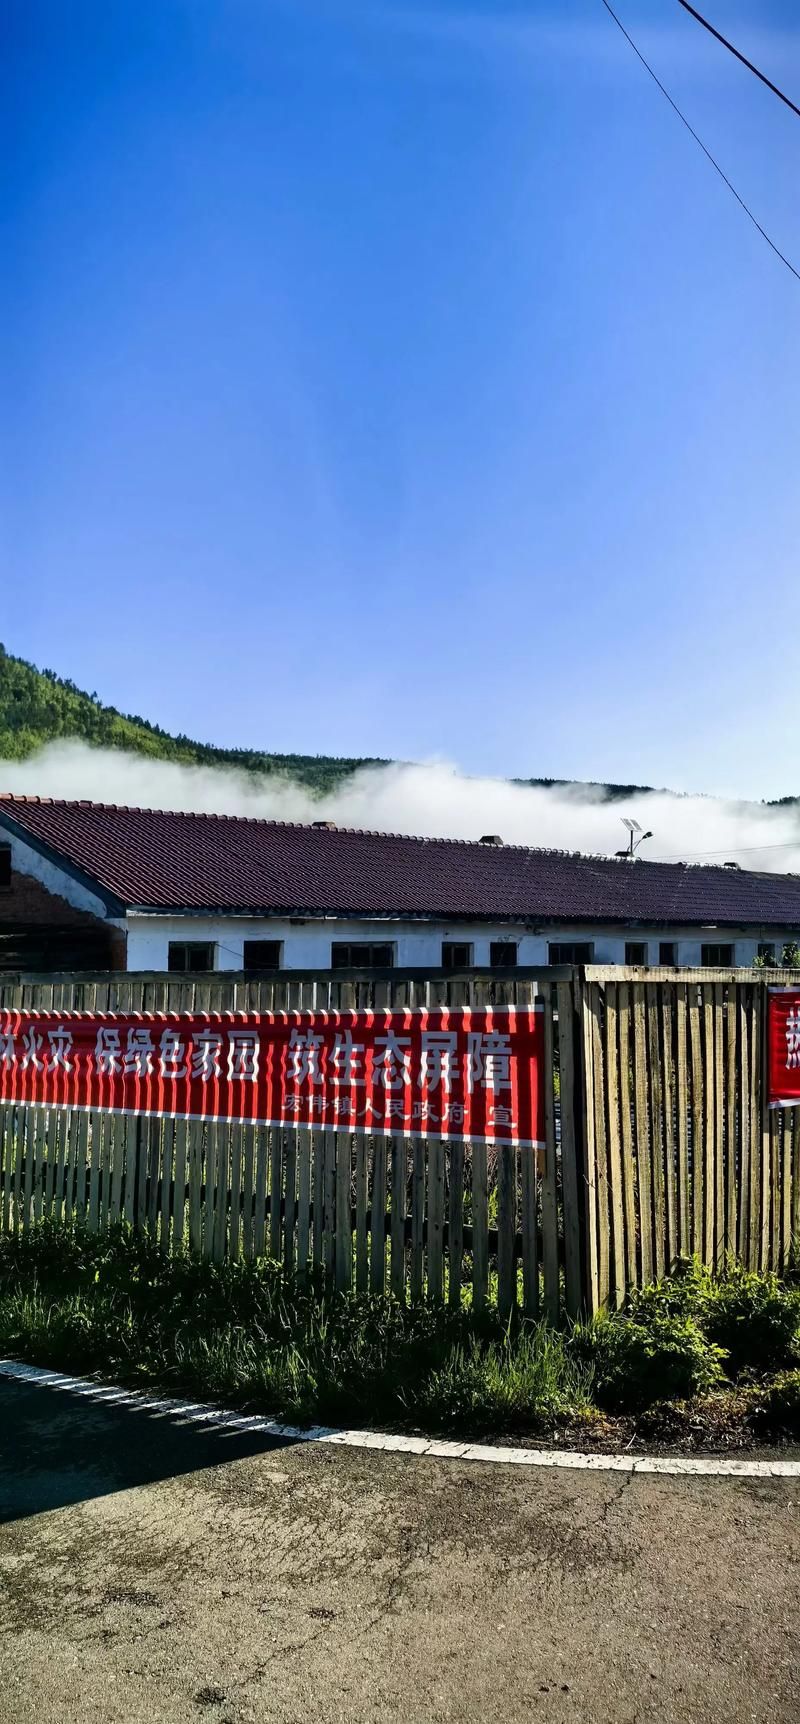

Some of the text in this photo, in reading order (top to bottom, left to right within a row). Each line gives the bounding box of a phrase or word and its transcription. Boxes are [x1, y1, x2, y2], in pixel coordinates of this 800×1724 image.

[95, 1026, 261, 1082] 保绿色家园
[287, 1028, 512, 1096] 筑生态屏障
[281, 1093, 518, 1128] 宏伟镇人民政府 宣
